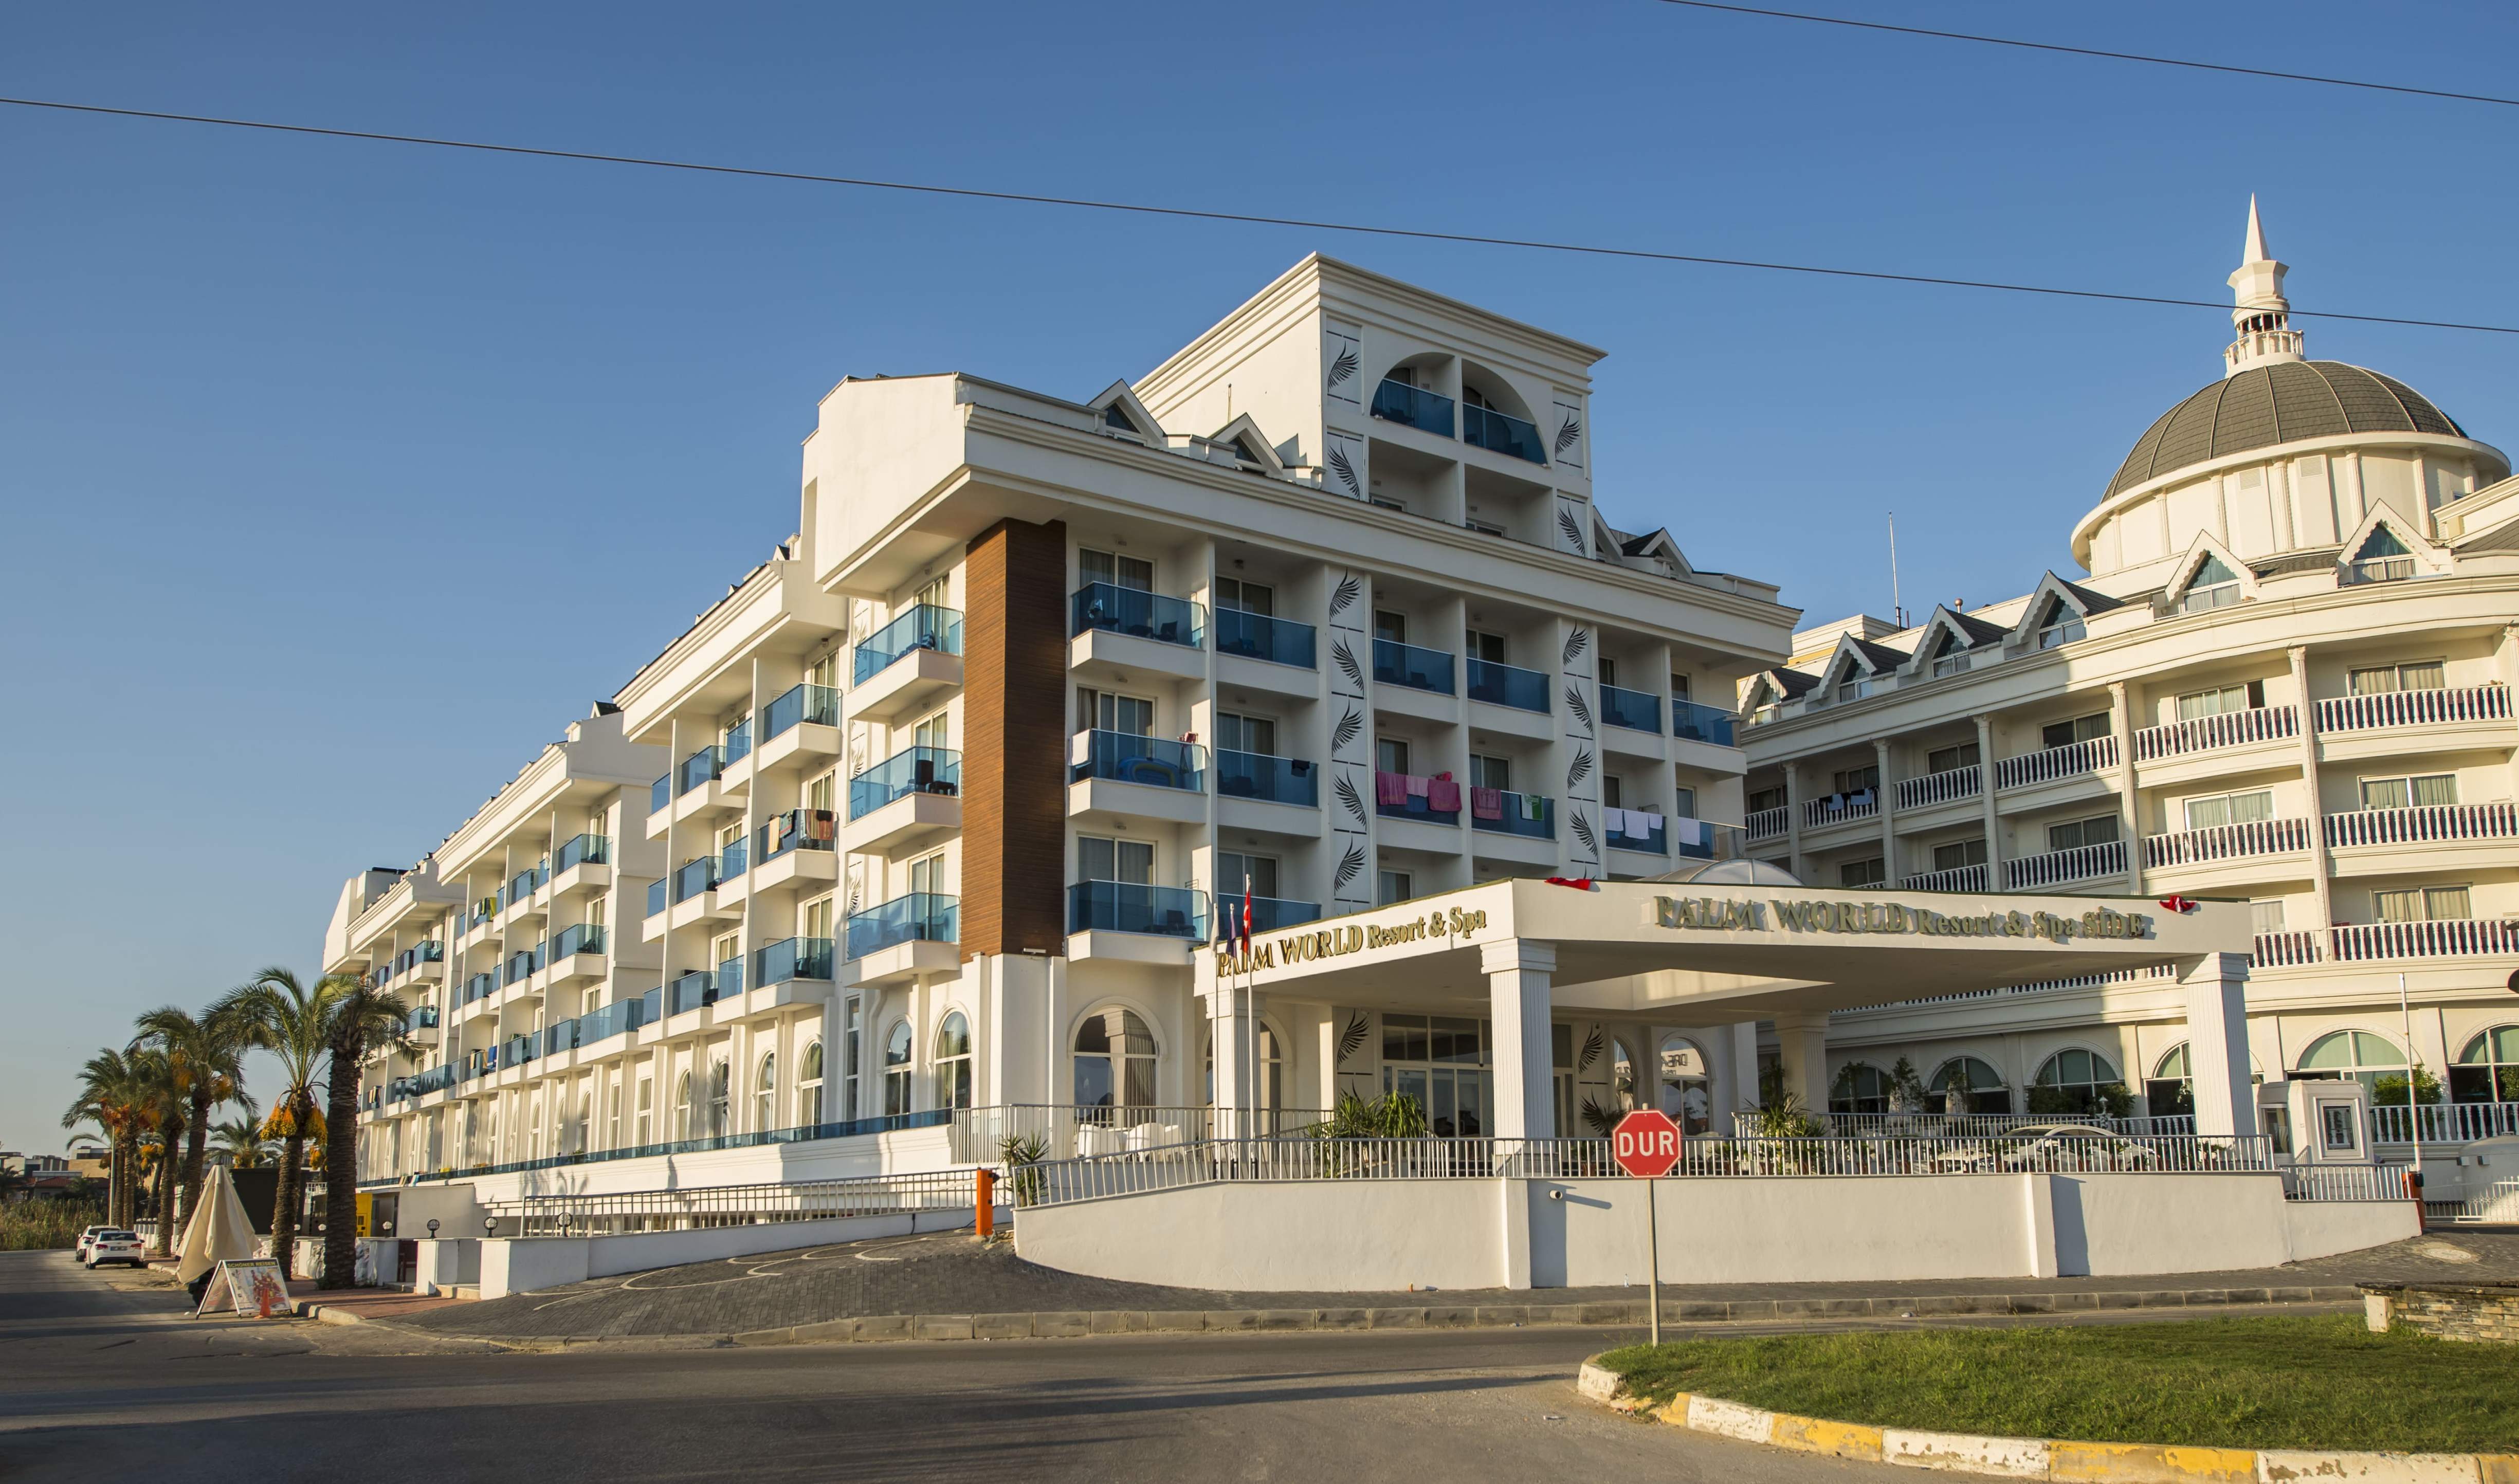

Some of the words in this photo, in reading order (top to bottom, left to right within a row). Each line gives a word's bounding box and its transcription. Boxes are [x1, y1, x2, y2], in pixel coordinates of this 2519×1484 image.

[1279, 925, 1363, 964] WORLD
[1366, 916, 1426, 949] Resort
[1429, 911, 1446, 938] &
[1449, 906, 1487, 939] Spa
[1653, 896, 1760, 929] PALM
[1767, 900, 1908, 931] WORLD
[1914, 909, 1997, 934] Resort
[2005, 910, 2024, 935] &
[2033, 910, 2076, 943] Spa
[1619, 1131, 1674, 1157] DUR
